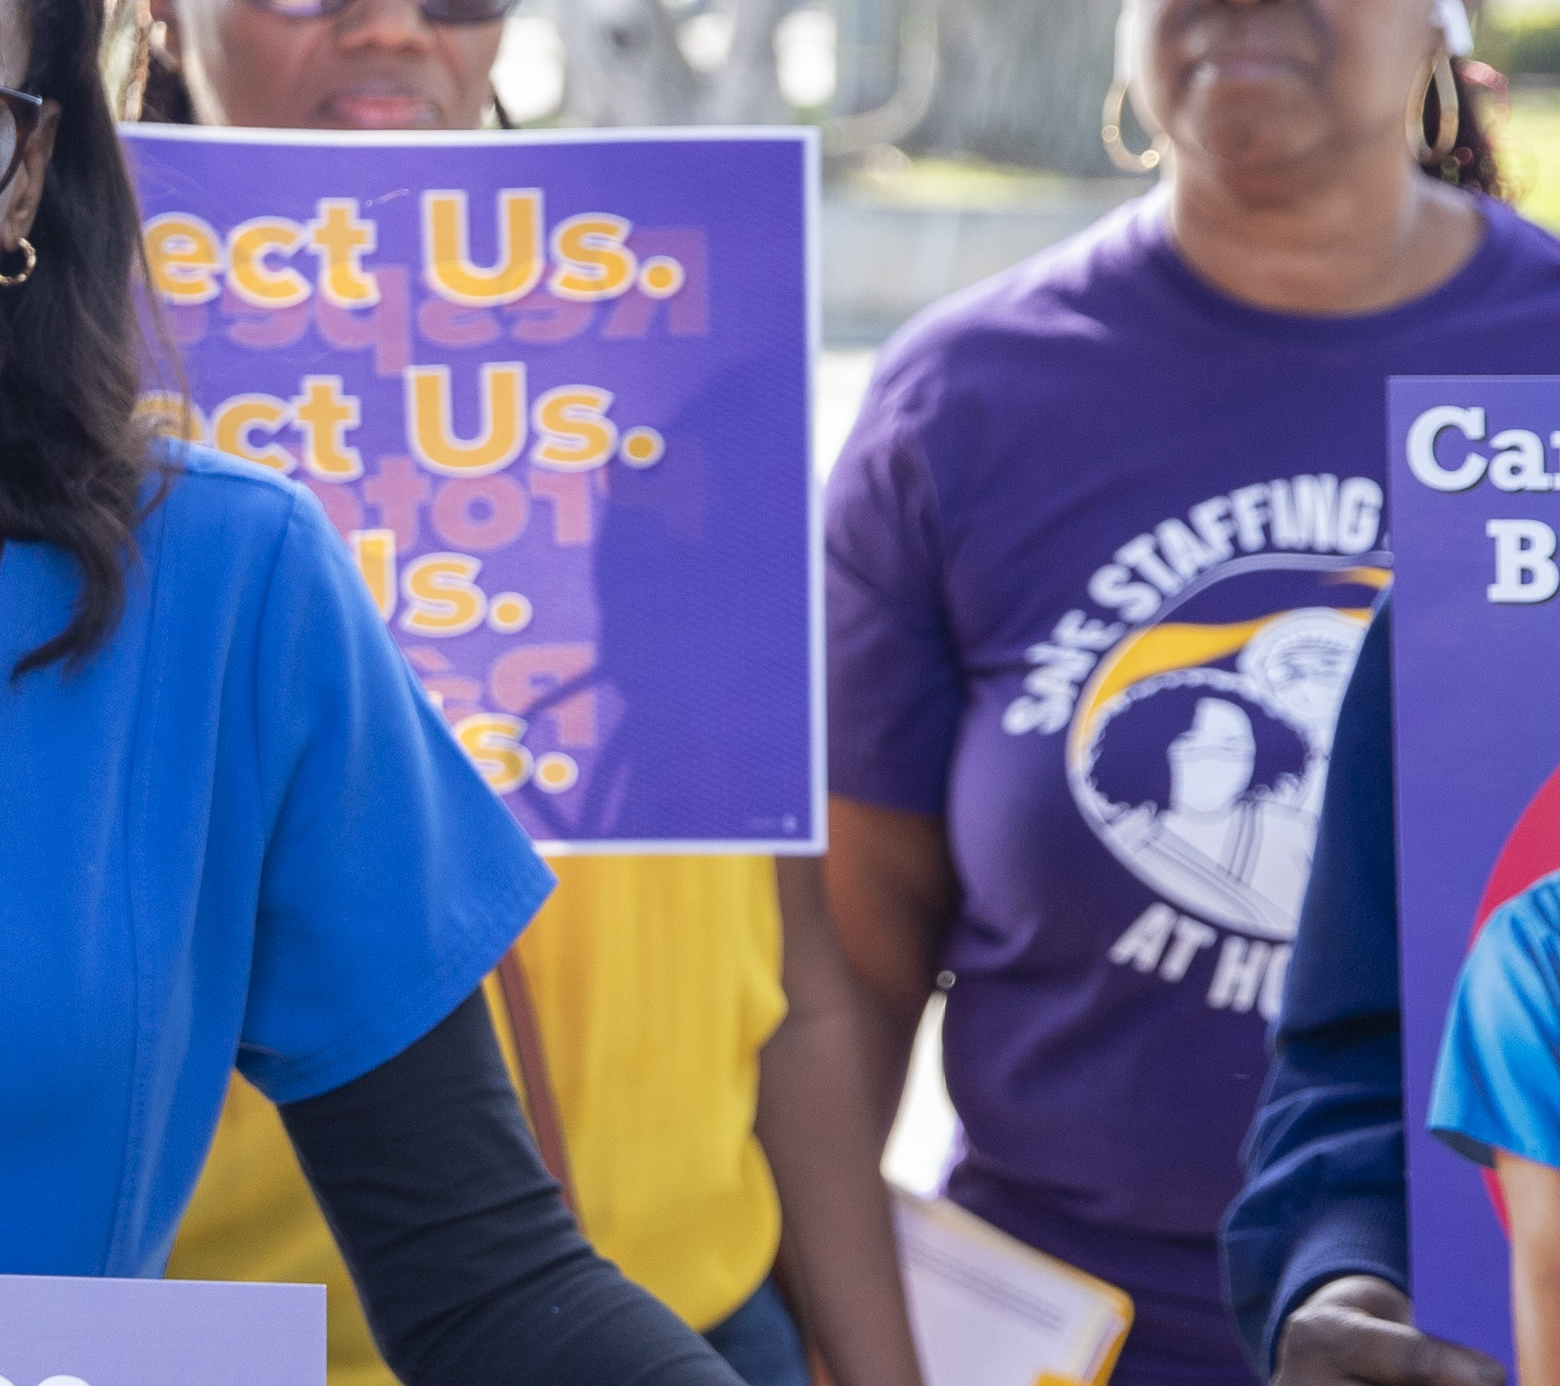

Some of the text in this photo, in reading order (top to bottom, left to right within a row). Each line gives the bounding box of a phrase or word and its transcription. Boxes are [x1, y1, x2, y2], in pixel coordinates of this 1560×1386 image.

[140, 187, 686, 308] ect Us.
[404, 361, 667, 477] Us.
[1087, 472, 1385, 624] STAFFING
[1108, 901, 1219, 984] AT
